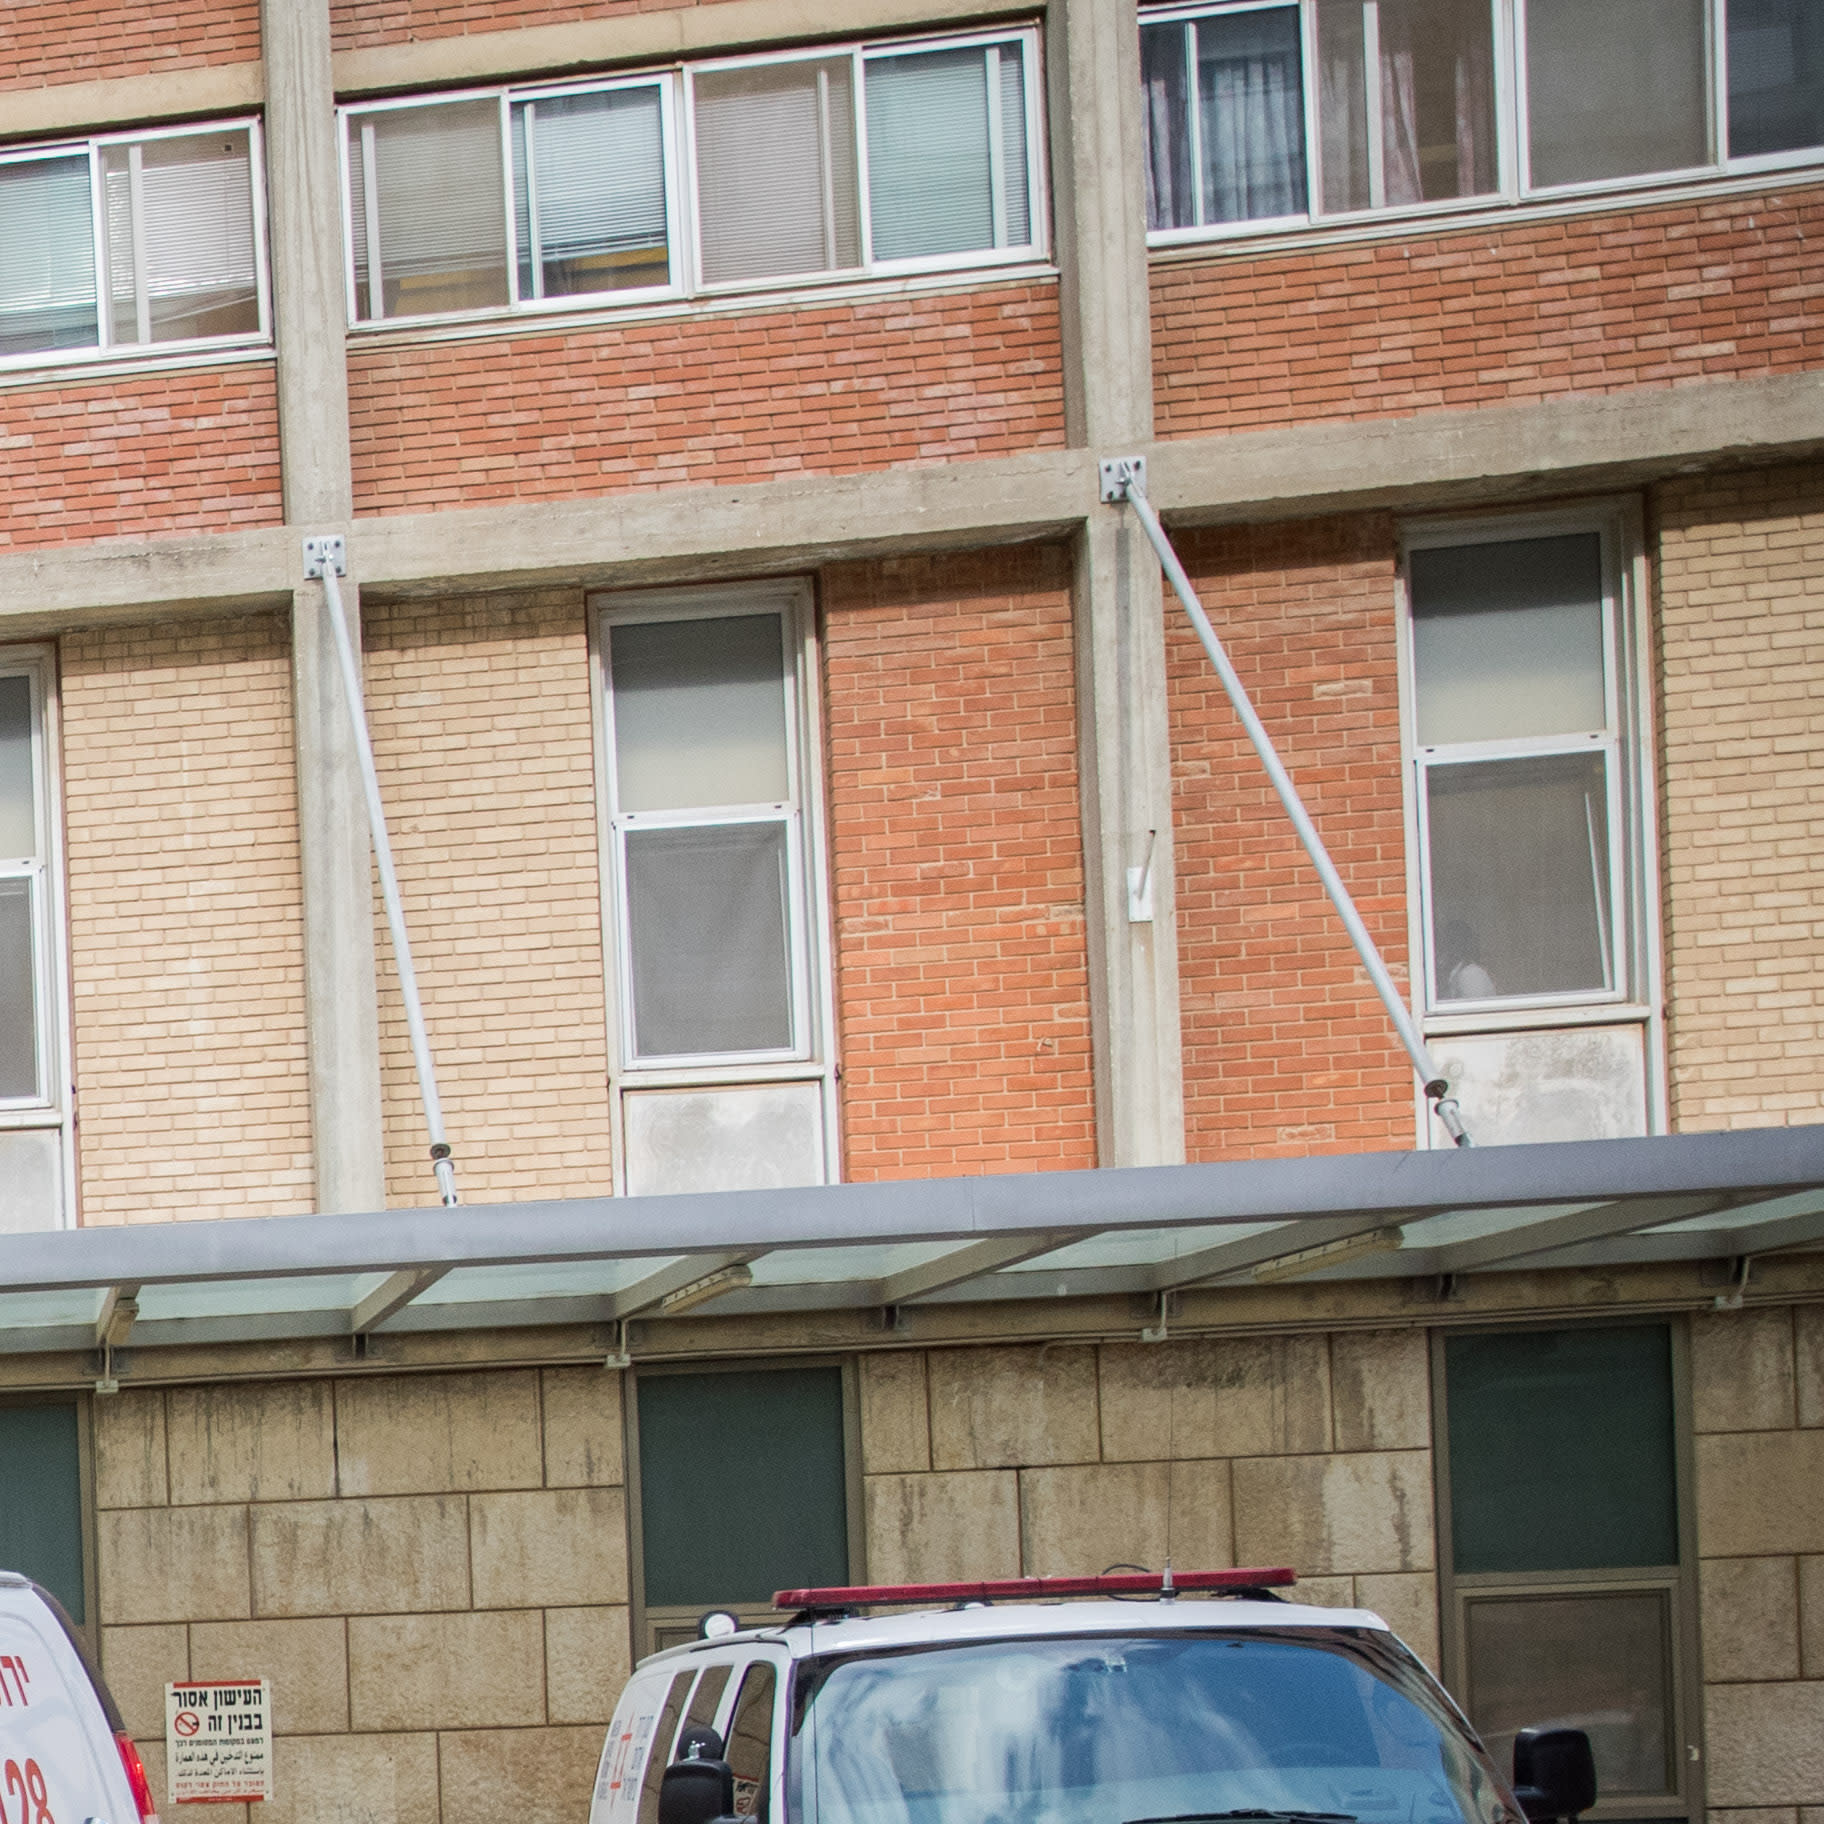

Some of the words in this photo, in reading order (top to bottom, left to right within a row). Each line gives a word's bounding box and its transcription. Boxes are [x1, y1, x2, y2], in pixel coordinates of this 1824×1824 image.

[171, 1690, 208, 1708] אסור
[214, 1689, 262, 1711] העישון
[208, 1715, 222, 1731] זה
